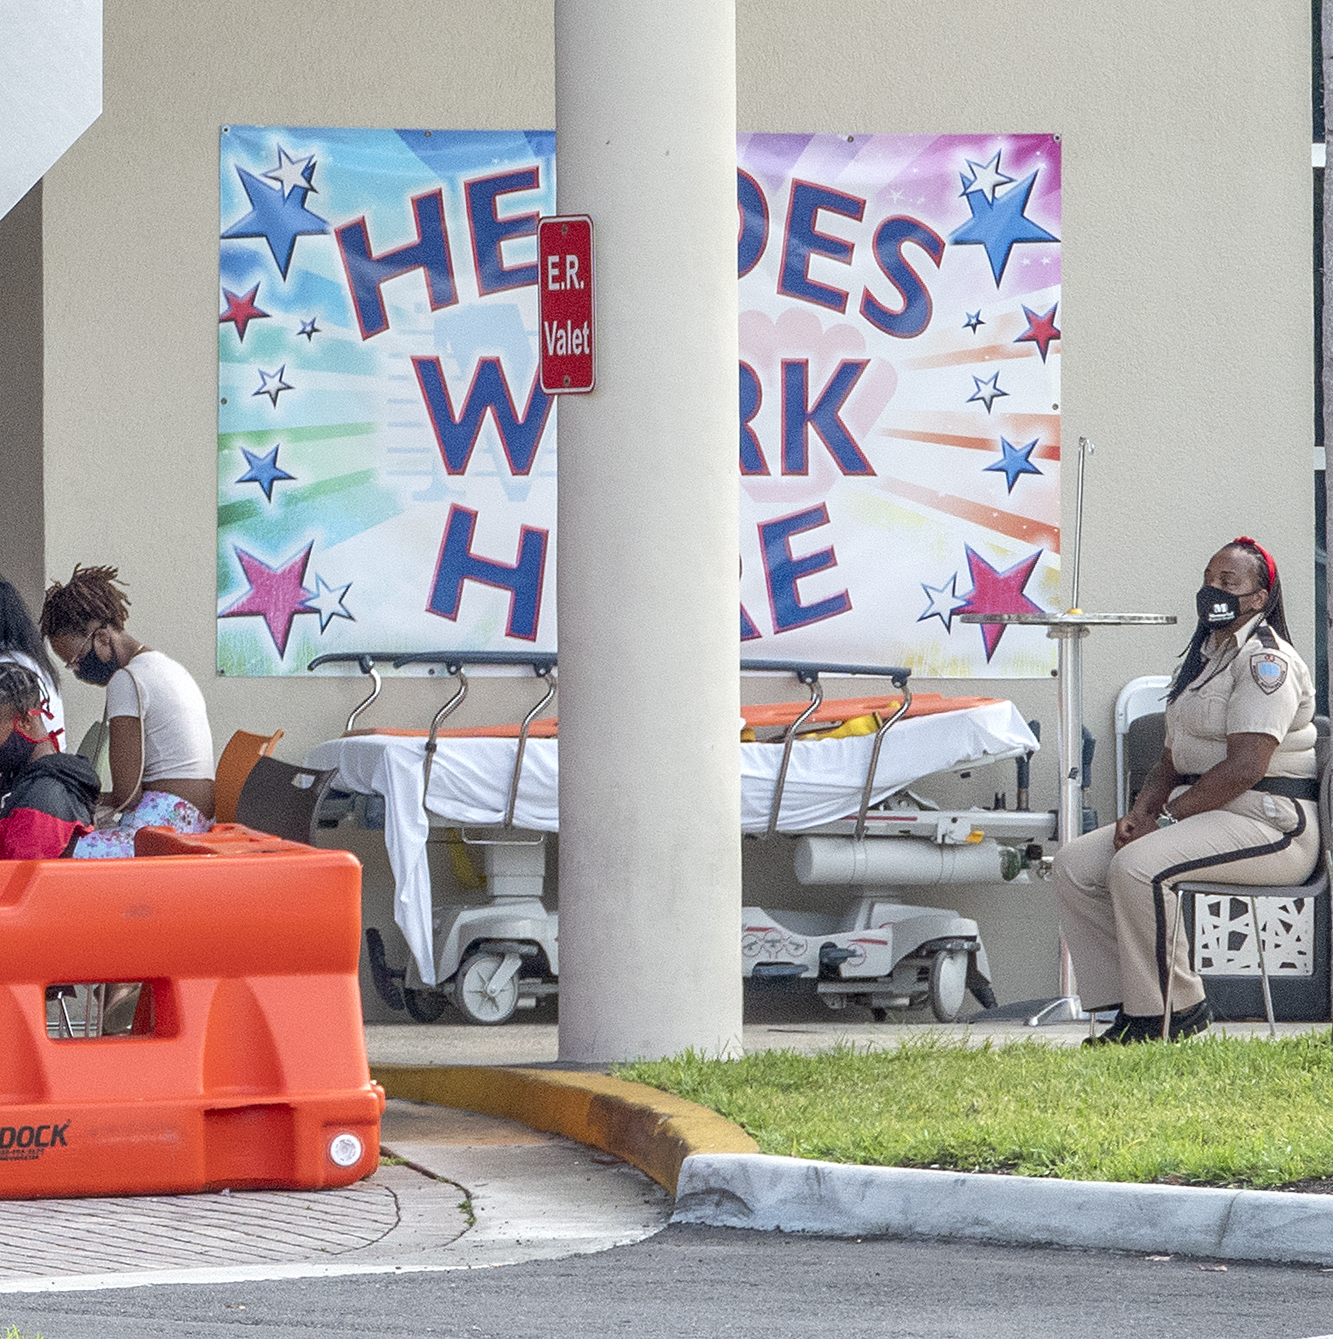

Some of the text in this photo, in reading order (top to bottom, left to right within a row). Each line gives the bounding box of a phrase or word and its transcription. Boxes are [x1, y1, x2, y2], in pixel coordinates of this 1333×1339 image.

[334, 165, 947, 340] HEES
[546, 254, 585, 292] E.R.
[543, 319, 591, 357] Valet
[411, 355, 878, 477] WK
[424, 500, 853, 643] HE
